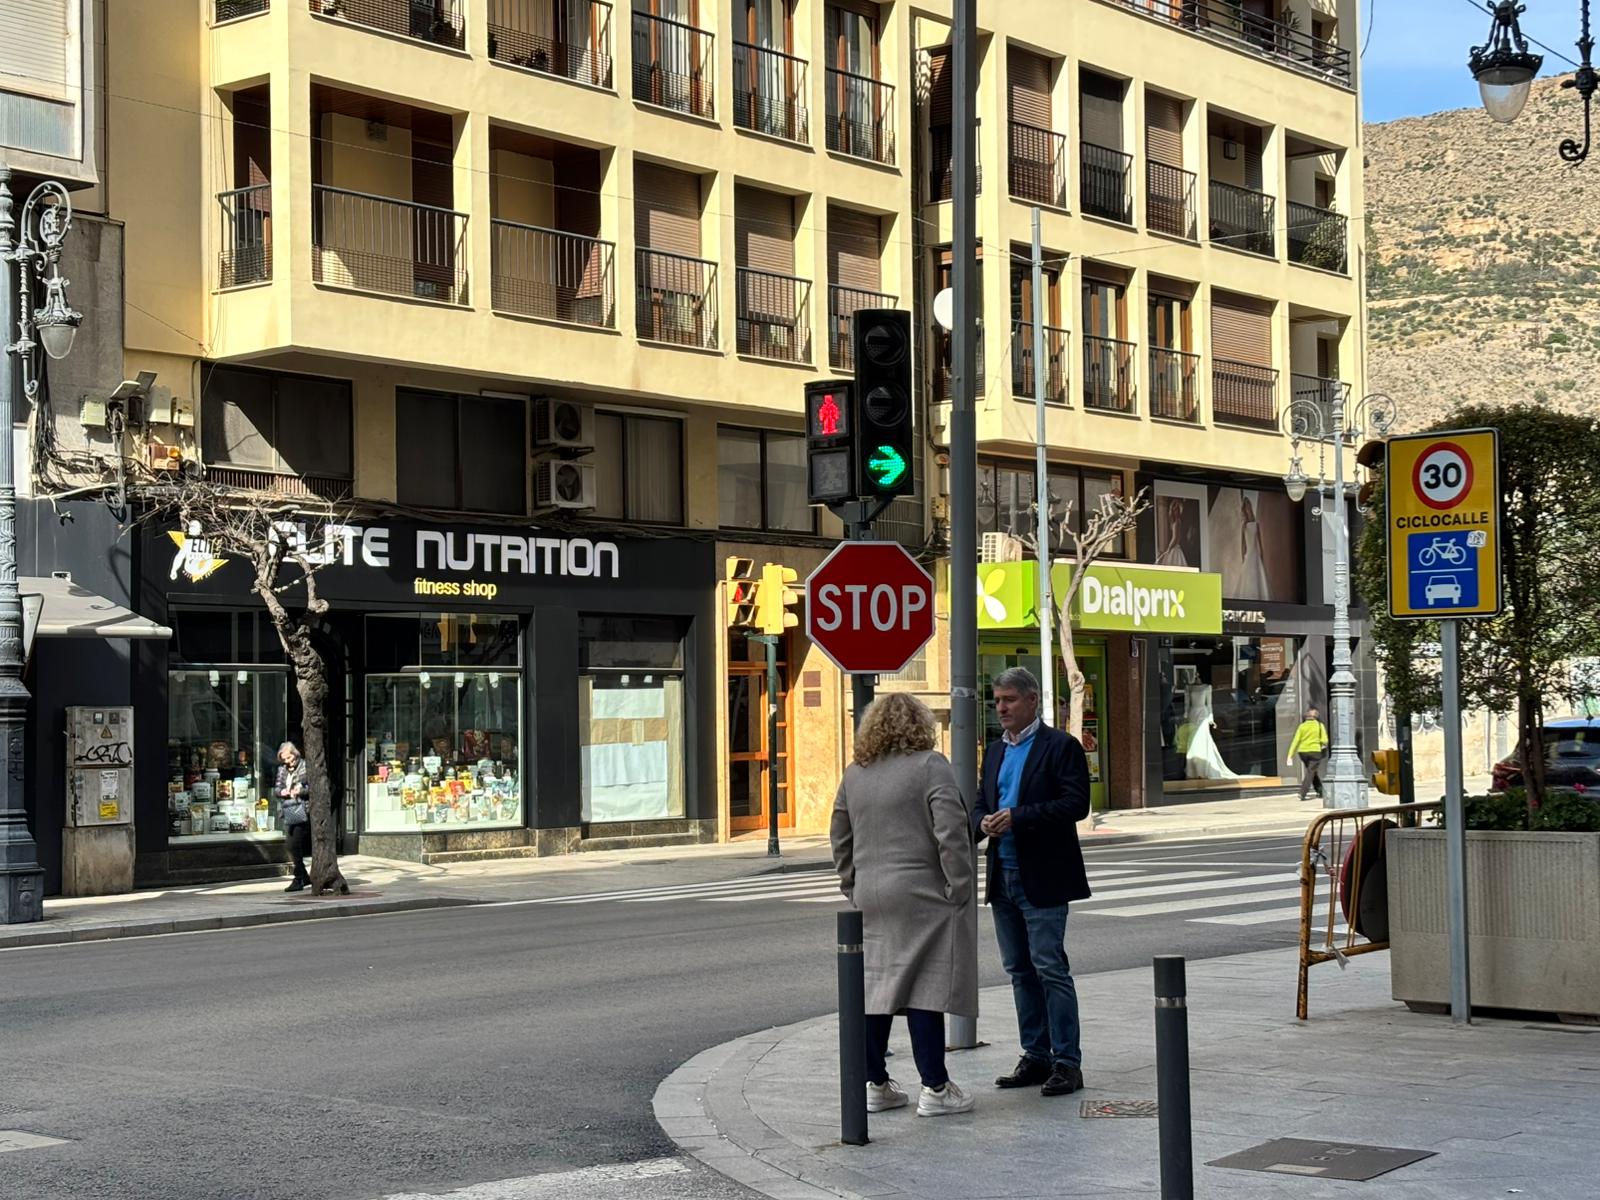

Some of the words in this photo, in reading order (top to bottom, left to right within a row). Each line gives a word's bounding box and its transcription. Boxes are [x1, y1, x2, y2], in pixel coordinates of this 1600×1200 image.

[1423, 462, 1462, 490] 30
[1396, 511, 1489, 529] CICLOCALLE
[268, 521, 390, 567] ELITE
[416, 530, 619, 578] NUTRITION
[414, 577, 460, 595] fitness
[463, 579, 497, 600] shop
[816, 583, 927, 632] STOP
[1082, 576, 1185, 626] Dialprix
